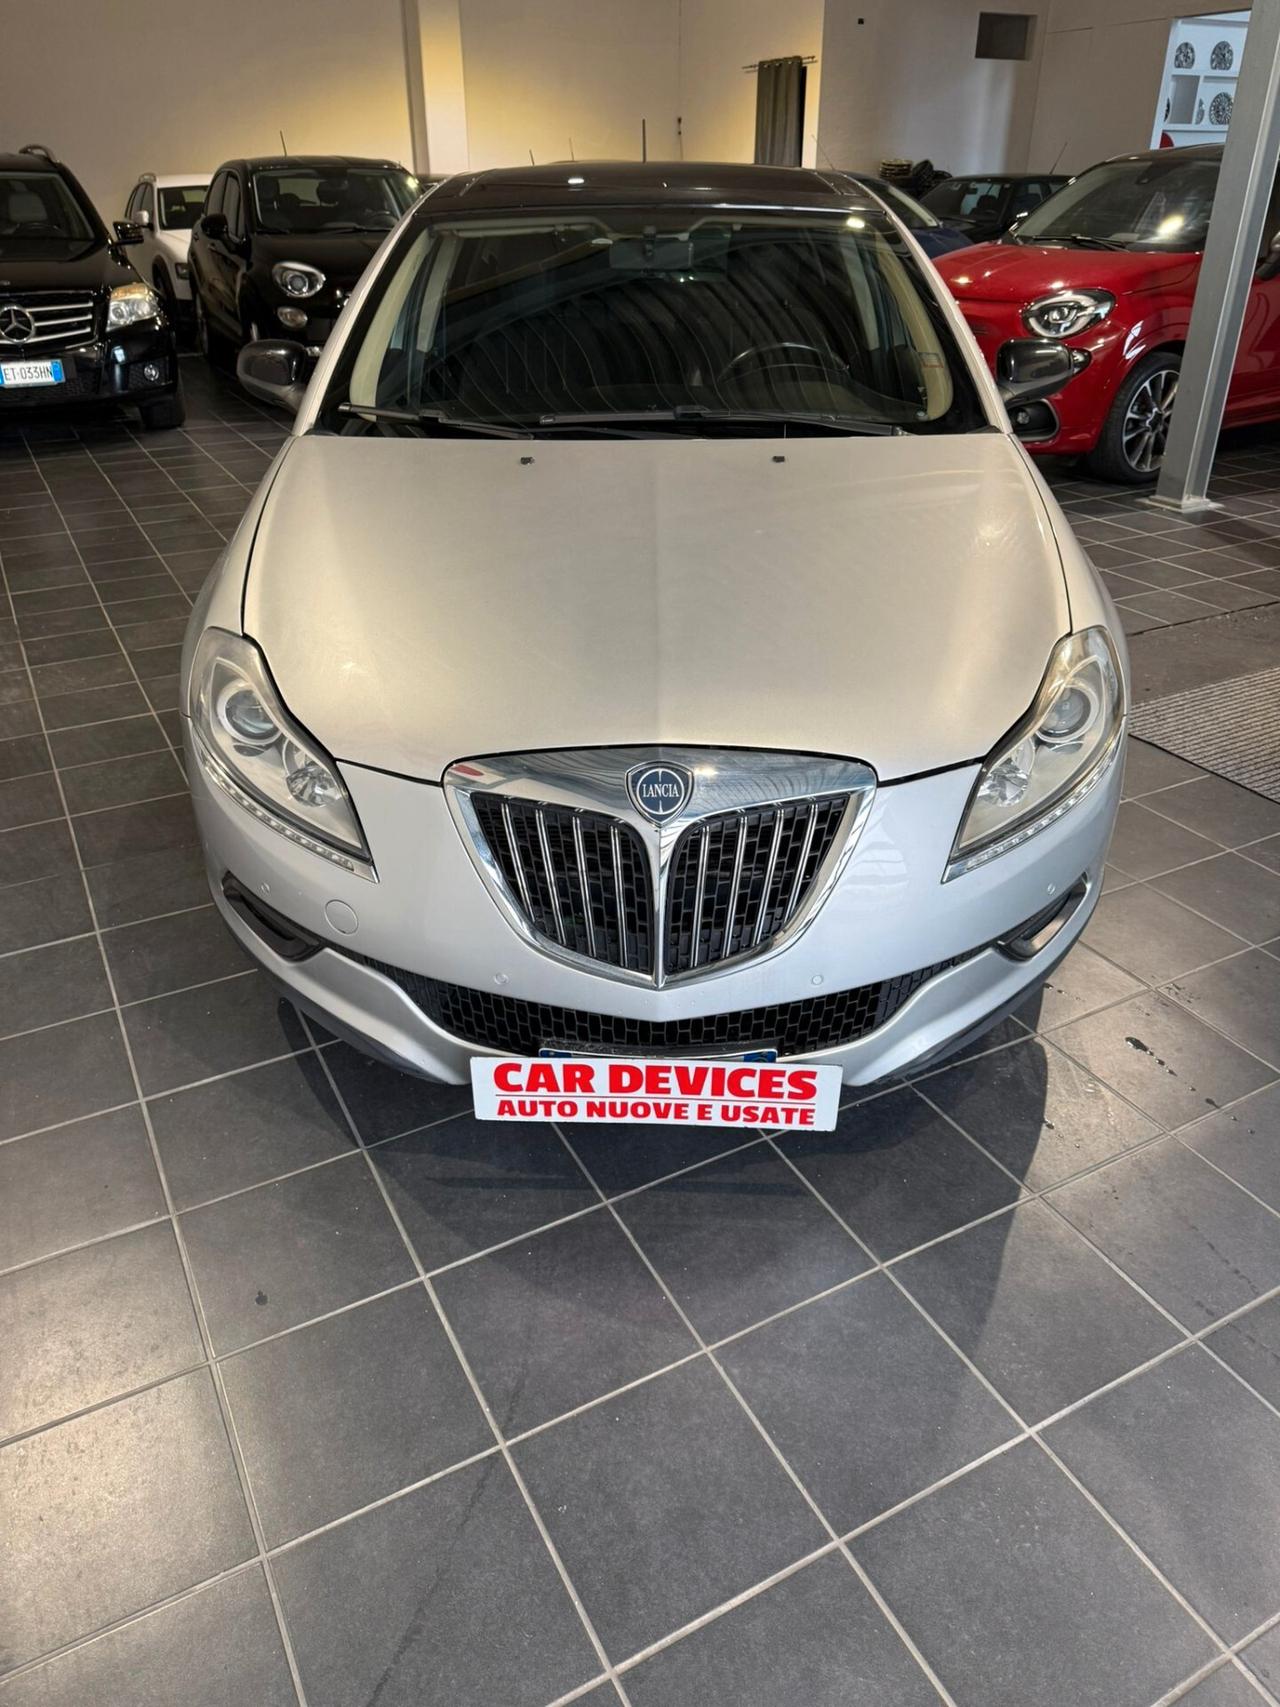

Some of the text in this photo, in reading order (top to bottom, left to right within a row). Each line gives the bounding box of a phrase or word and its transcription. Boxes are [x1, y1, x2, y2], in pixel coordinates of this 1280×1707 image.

[3, 367, 16, 381] ET
[642, 783, 680, 798] LANCIA
[493, 1062, 817, 1101] CAR DEVICES
[497, 1099, 815, 1126] AUTO NUOVE E USATE
